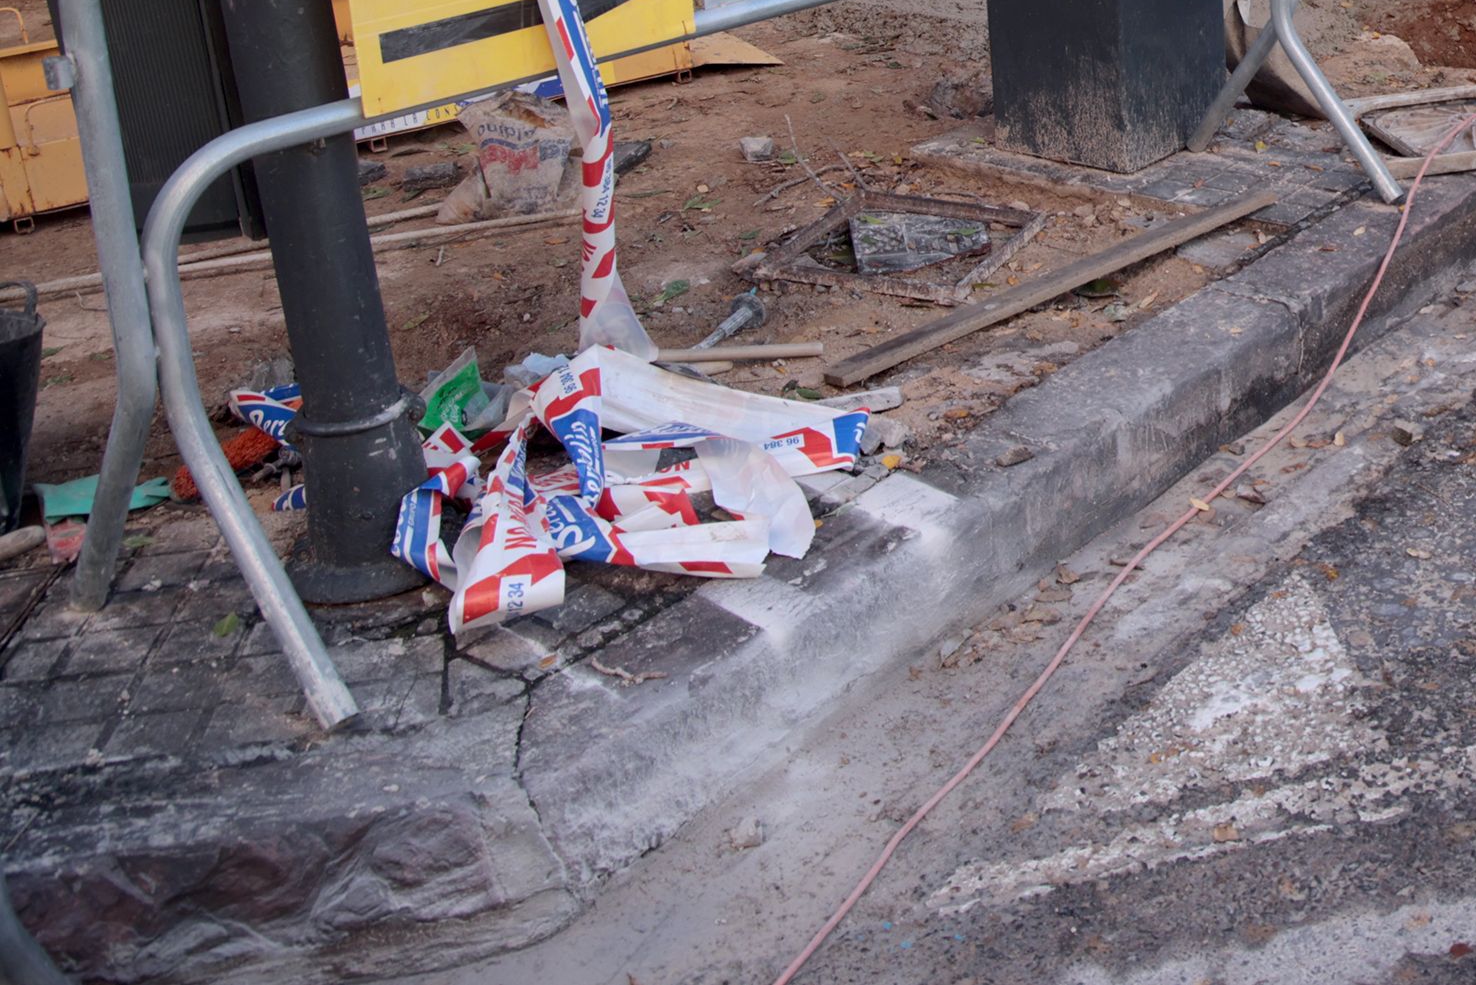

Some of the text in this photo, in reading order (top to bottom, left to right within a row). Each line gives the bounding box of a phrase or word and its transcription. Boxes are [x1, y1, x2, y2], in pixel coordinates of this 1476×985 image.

[763, 436, 800, 451] 96 384
[508, 582, 525, 598] 34
